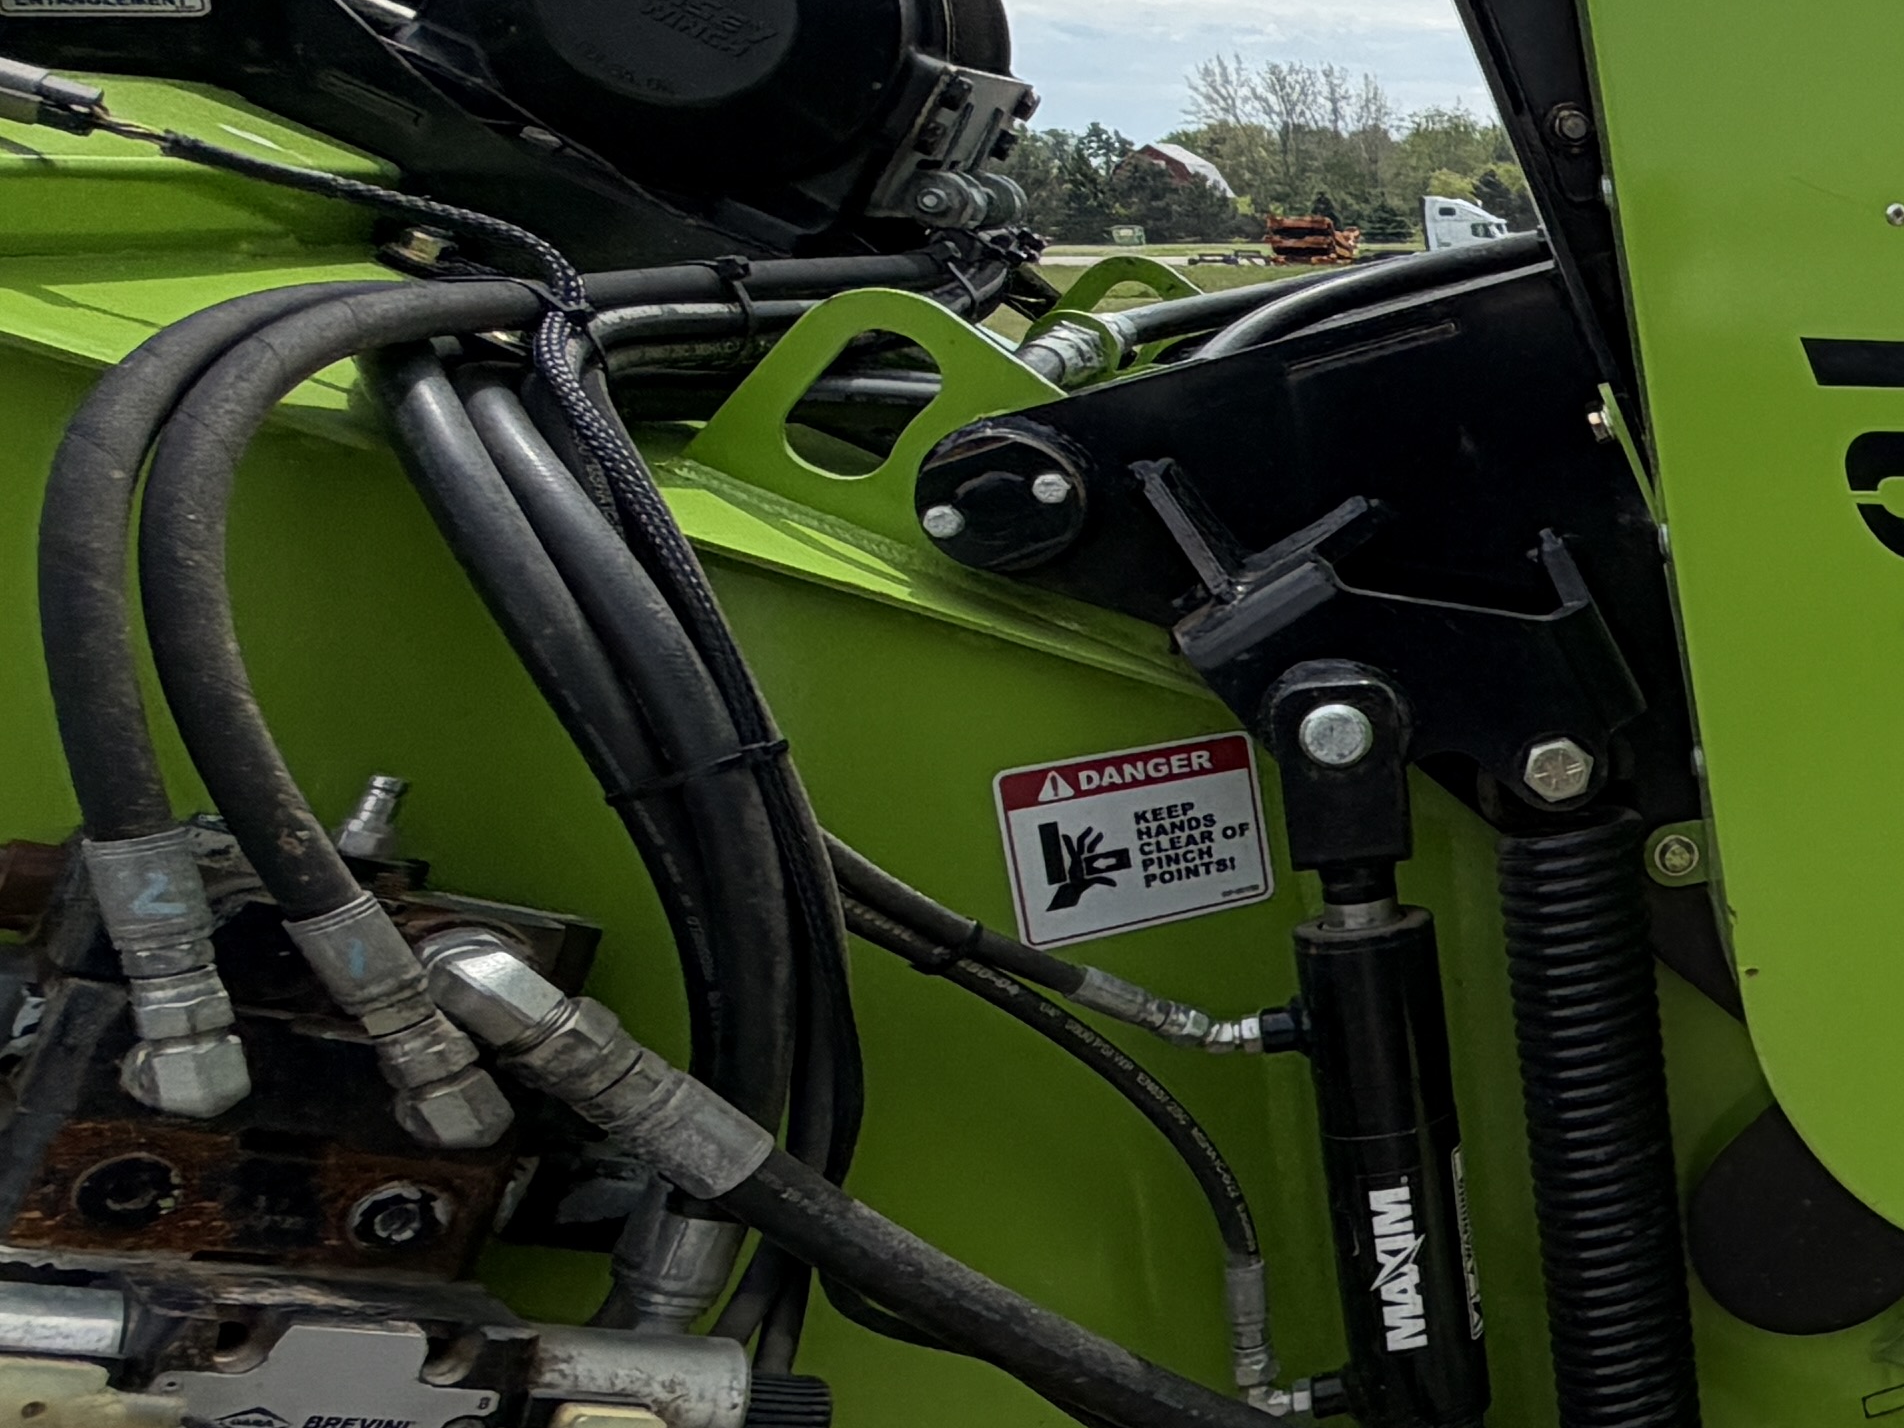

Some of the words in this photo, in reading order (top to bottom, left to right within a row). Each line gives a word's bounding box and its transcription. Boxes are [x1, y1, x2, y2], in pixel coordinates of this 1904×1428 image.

[1078, 750, 1213, 790] DANGER
[1134, 801, 1195, 825] KEEP
[1136, 813, 1217, 841] HANDS
[1139, 828, 1214, 856] CLEAR
[1222, 822, 1250, 840] OF
[1141, 845, 1213, 872] PINCH
[1144, 856, 1236, 888] POINTS!
[130, 871, 188, 915] 2
[1368, 1185, 1428, 1352] MAXIM
